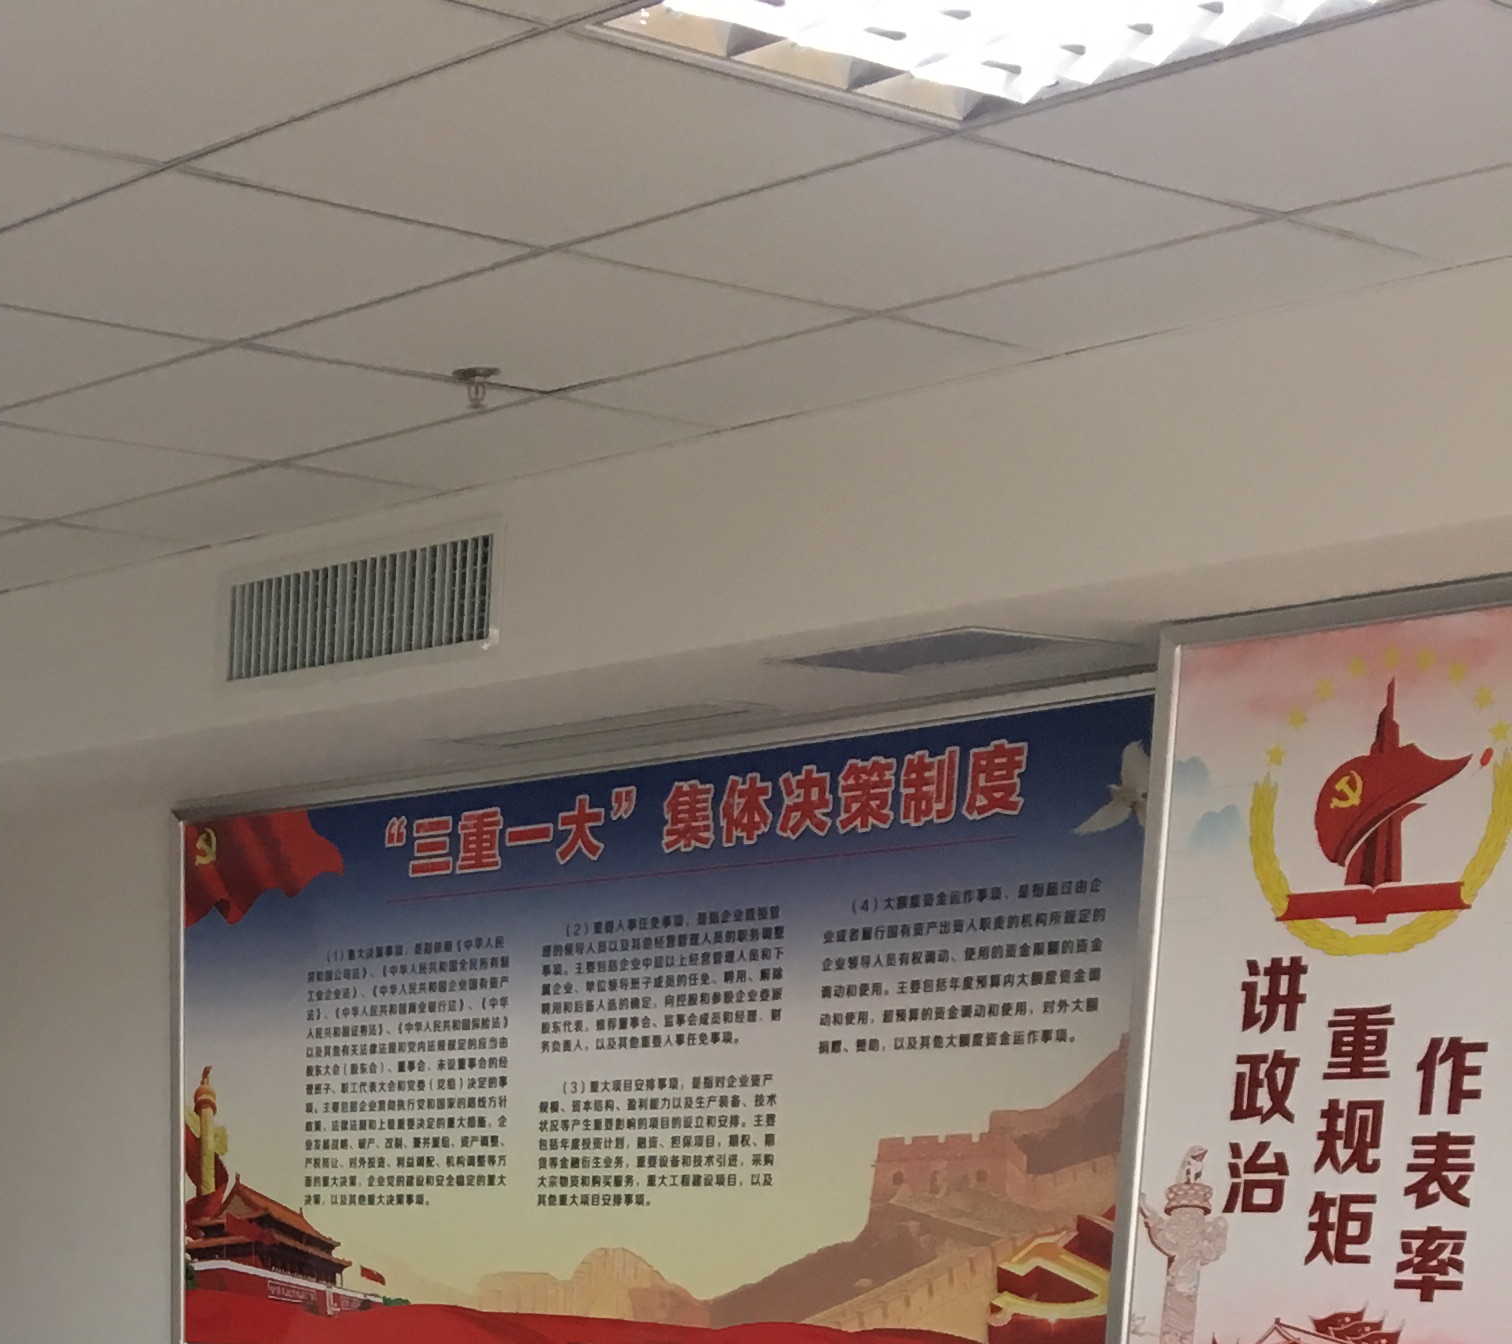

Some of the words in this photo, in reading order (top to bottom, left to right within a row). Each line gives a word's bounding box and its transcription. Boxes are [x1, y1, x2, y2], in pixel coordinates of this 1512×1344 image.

[664, 740, 1030, 851] 集体决策制度
[1222, 956, 1309, 1216] 讲政治
[1303, 1003, 1396, 1268] 重规矩
[1393, 1035, 1489, 1304] 作表率
